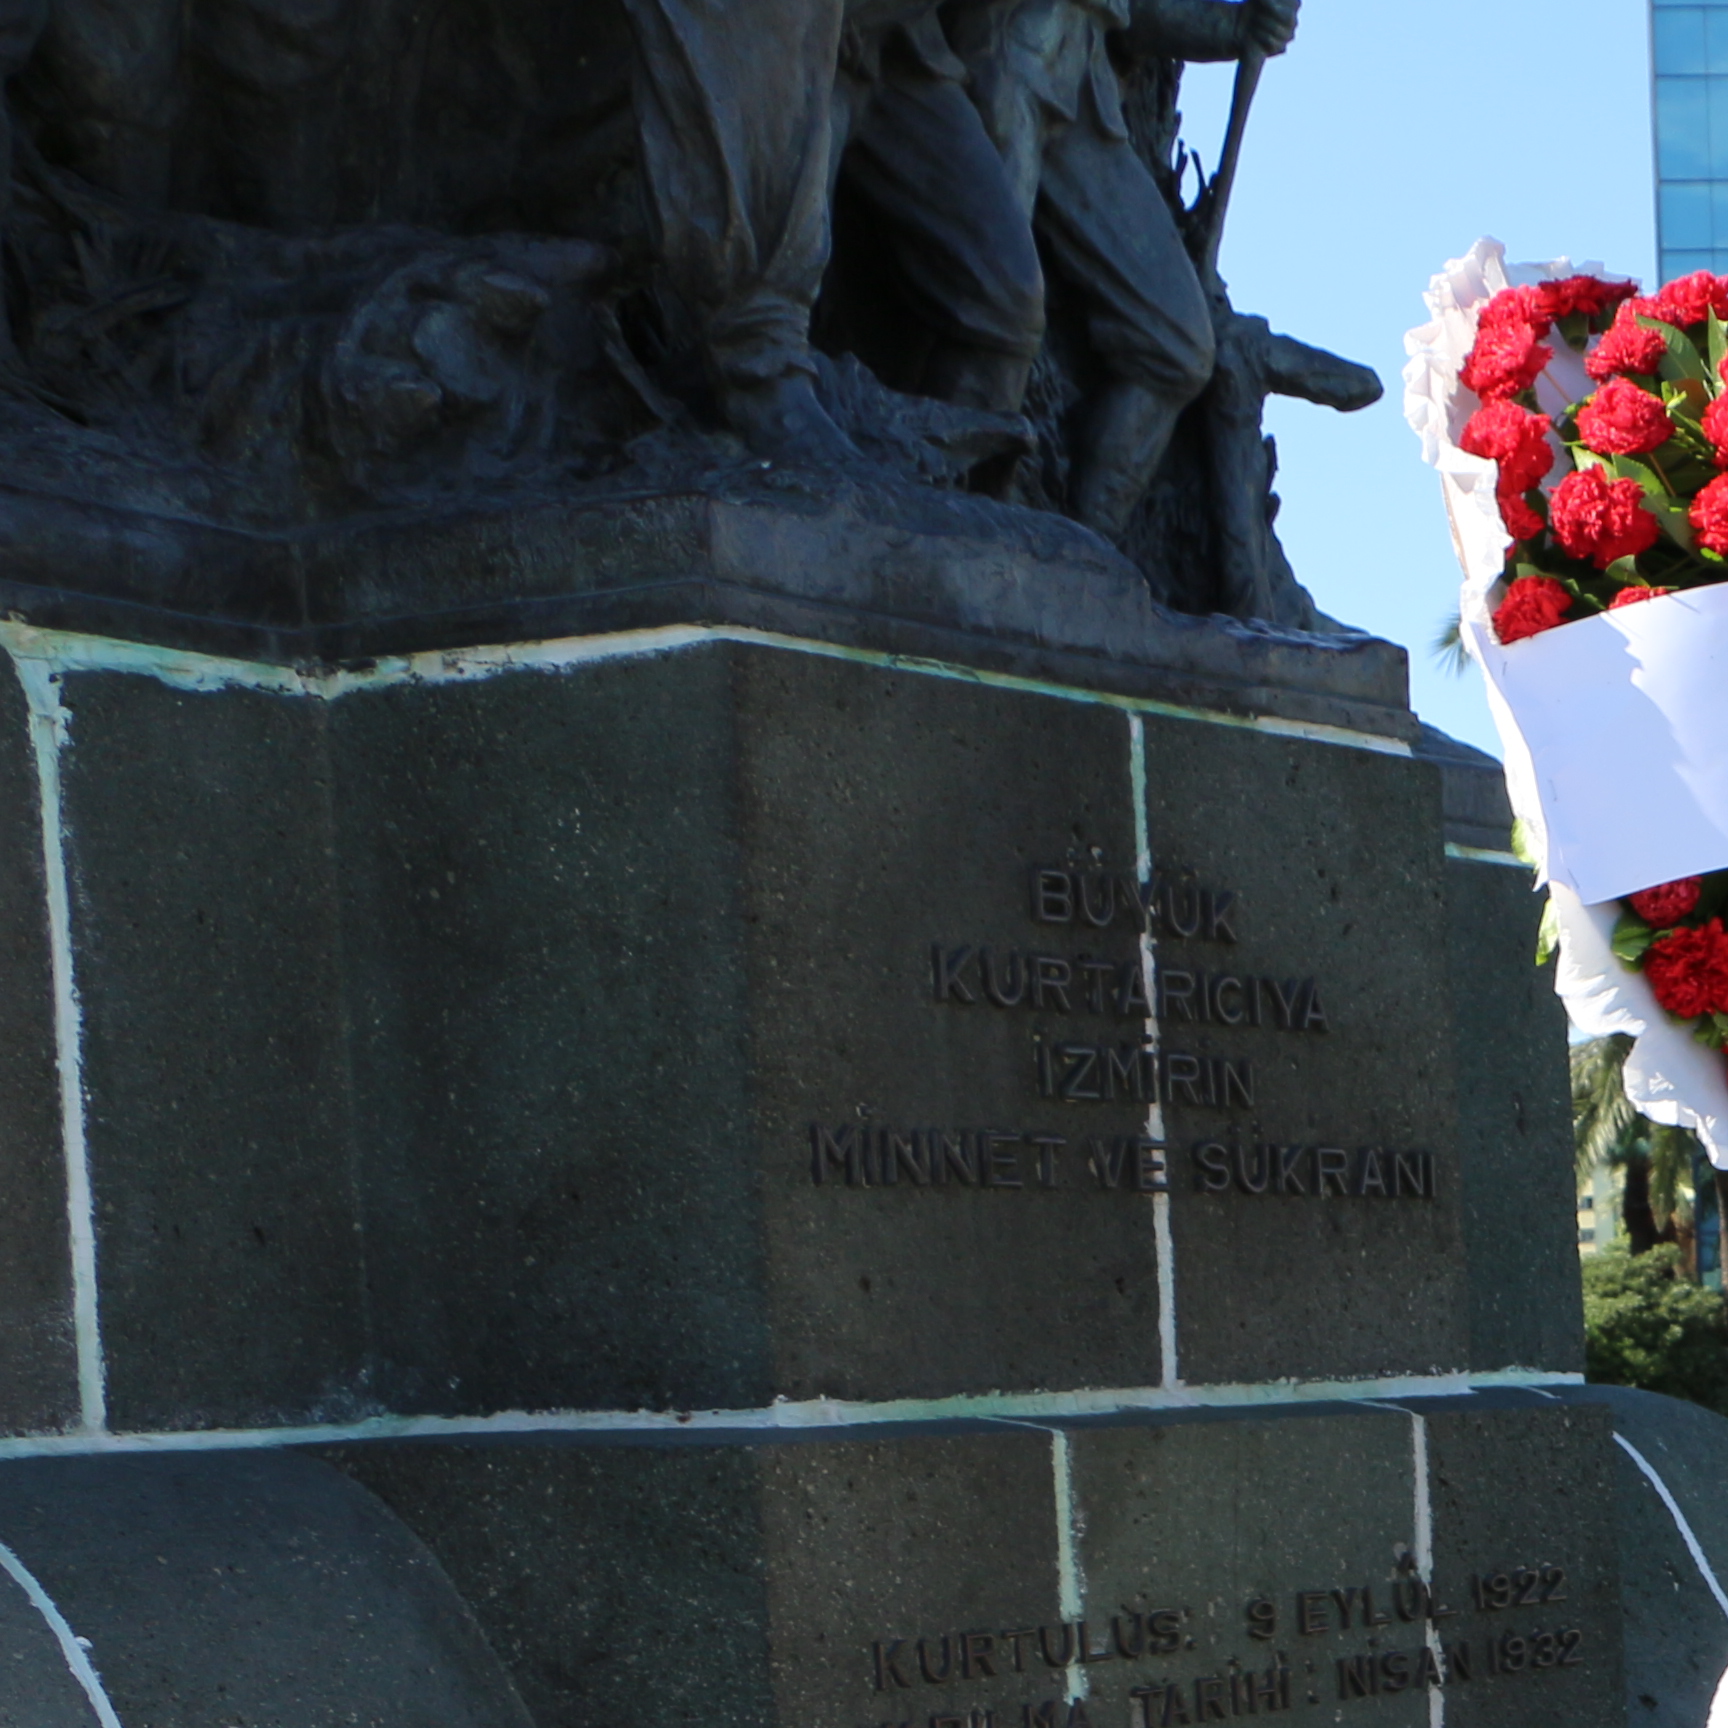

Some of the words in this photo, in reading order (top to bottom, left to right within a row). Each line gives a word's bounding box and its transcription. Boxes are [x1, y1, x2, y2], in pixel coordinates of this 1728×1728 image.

[1030, 846, 1238, 943] BÜYÜK
[930, 942, 1331, 1033] KURTARICIYA
[1086, 1134, 1170, 1191] VE
[1246, 1597, 1278, 1641] 9
[1472, 1564, 1568, 1611] 1922
[1336, 1638, 1472, 1701] NİSAN
[1487, 1628, 1584, 1675] 1932
